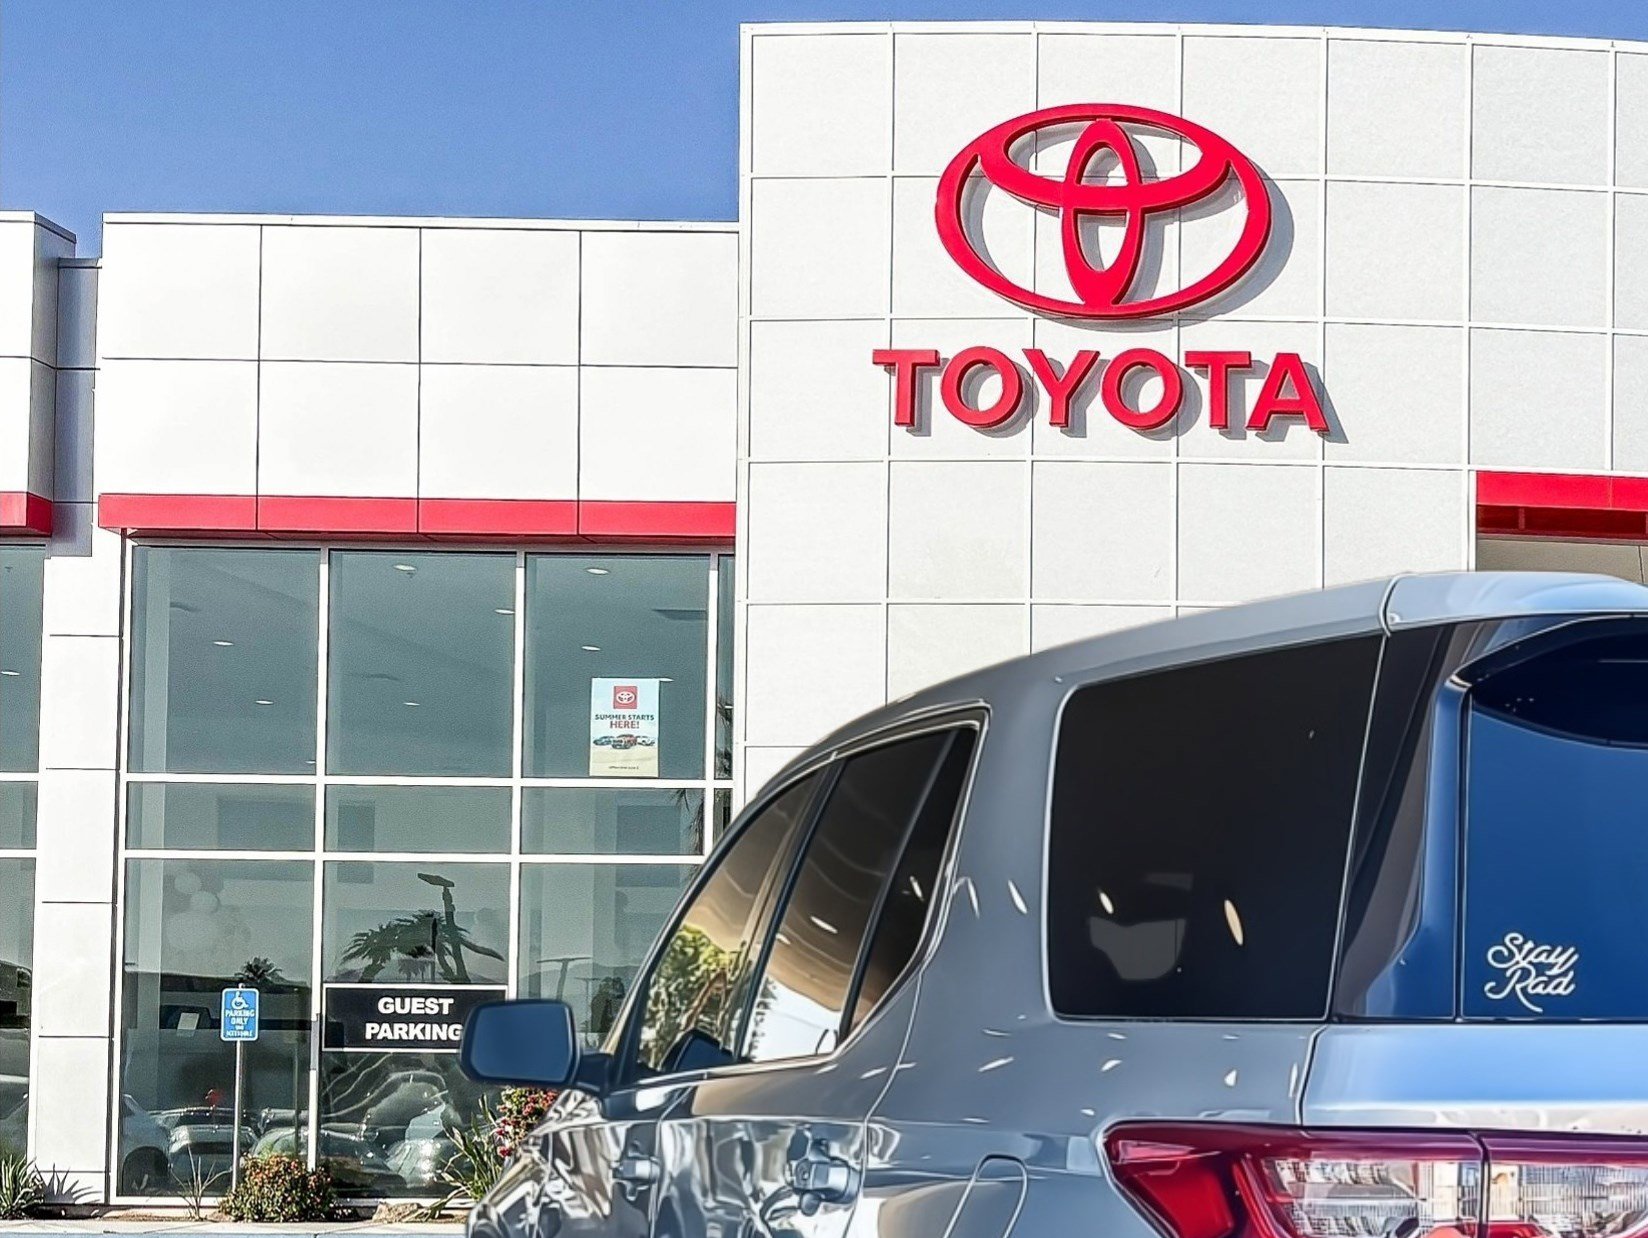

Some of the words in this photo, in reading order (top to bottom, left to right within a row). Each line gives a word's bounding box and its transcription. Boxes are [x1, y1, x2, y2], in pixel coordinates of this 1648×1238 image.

[872, 345, 1329, 432] TOYOTA
[594, 713, 627, 721] SUMMER
[609, 720, 640, 729] HERE!
[1486, 932, 1579, 976] Stay
[1484, 962, 1576, 1013] Rad
[225, 1009, 256, 1018] PARKING
[377, 996, 455, 1015] GUEST
[230, 1017, 249, 1025] ONLY
[364, 1022, 464, 1041] PARKING
